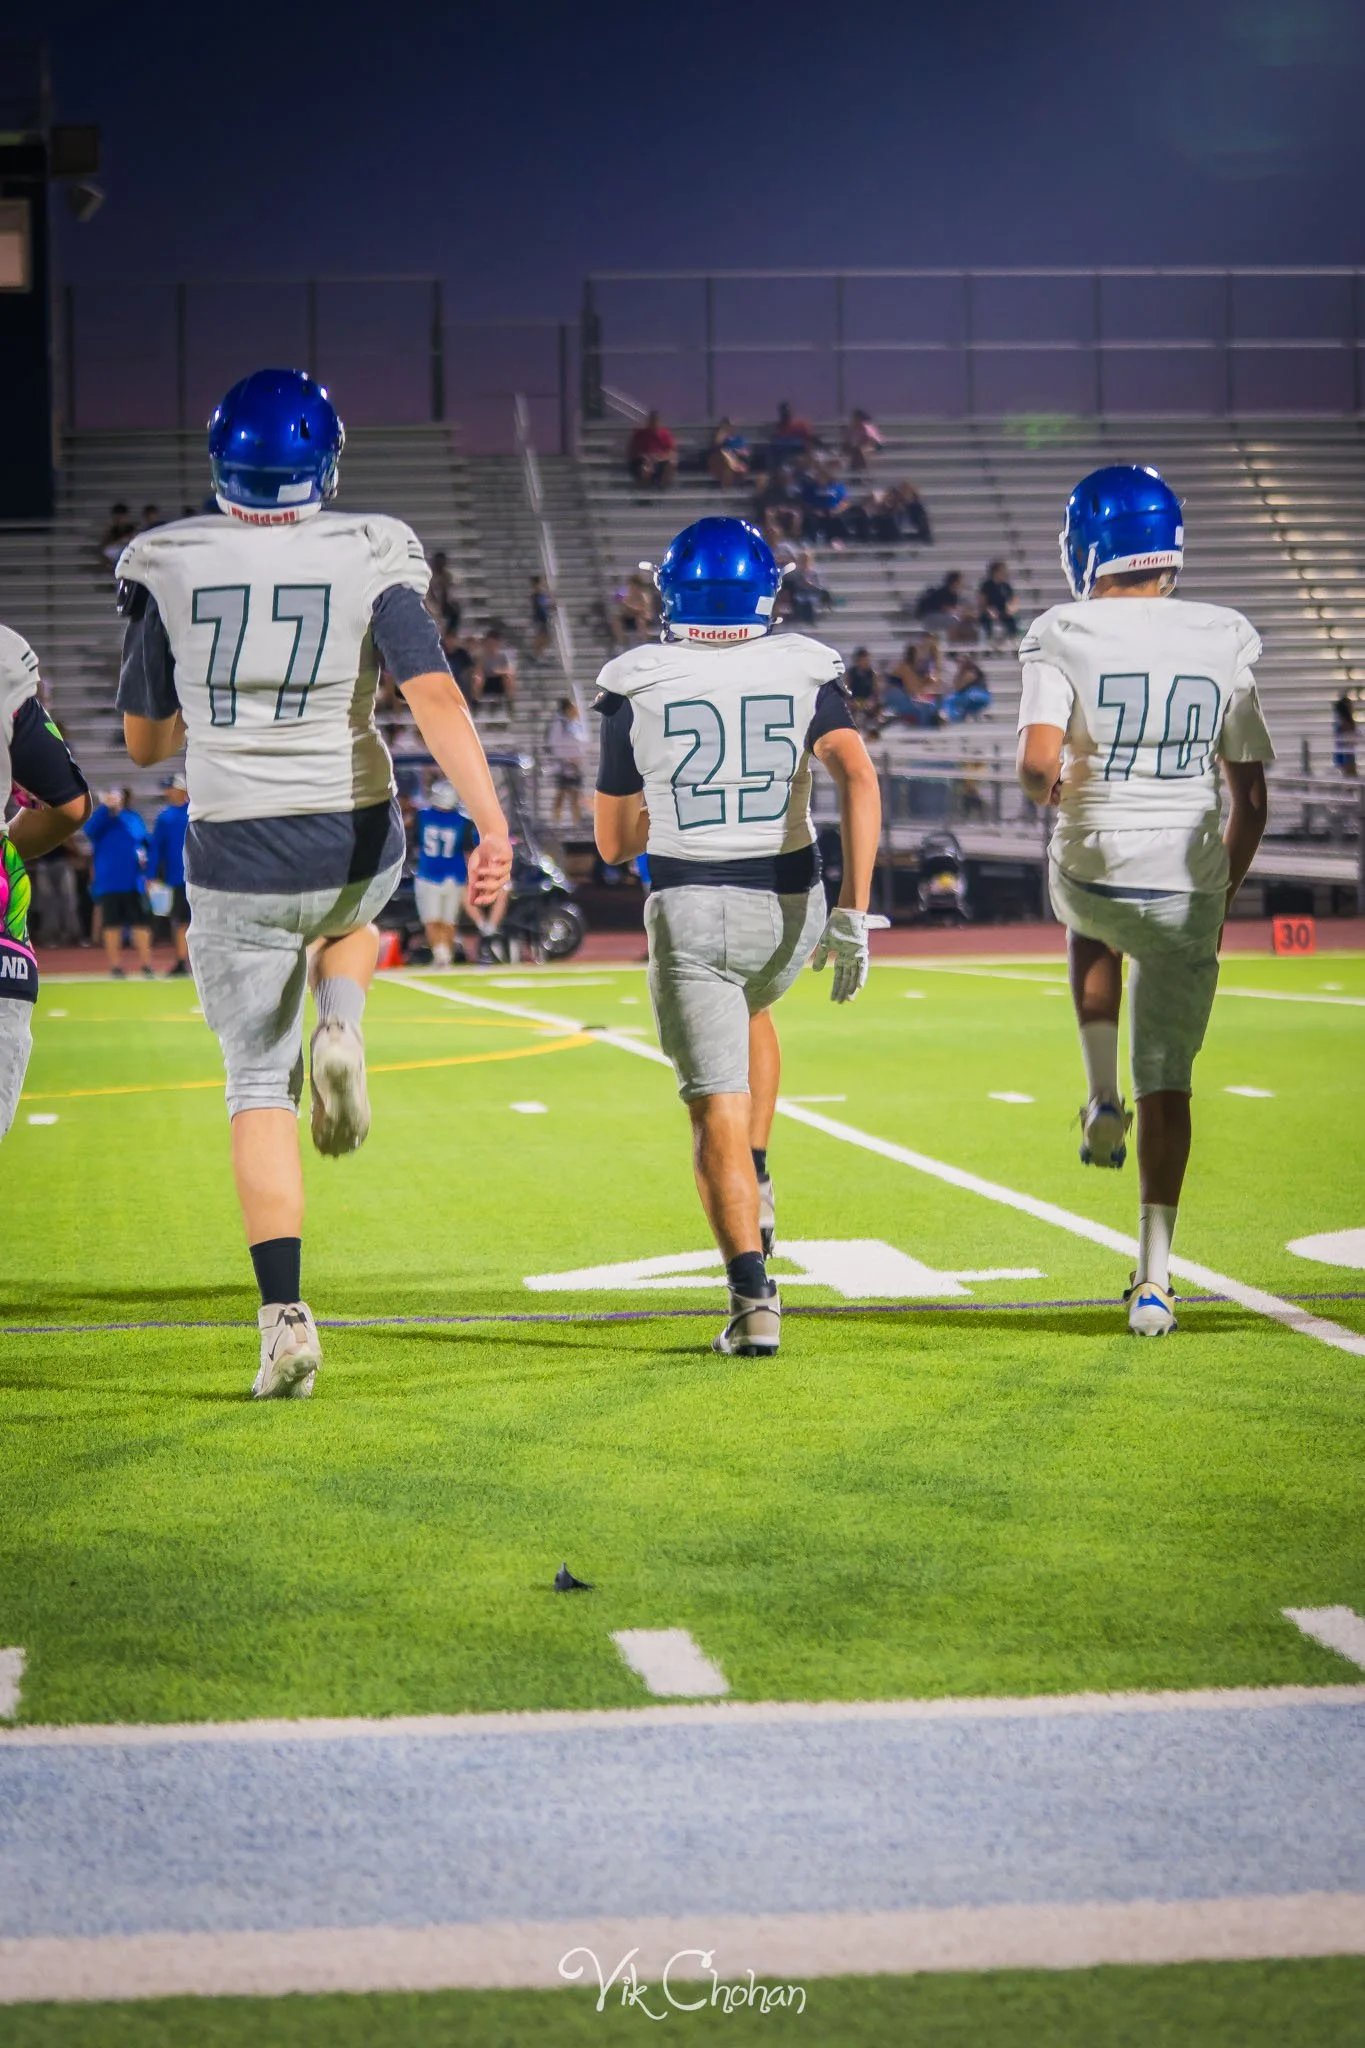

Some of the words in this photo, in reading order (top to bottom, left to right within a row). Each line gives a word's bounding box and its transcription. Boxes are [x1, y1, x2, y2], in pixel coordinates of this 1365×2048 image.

[688, 627, 749, 640] Riddell
[191, 583, 332, 727] 77
[663, 694, 797, 831] 25
[423, 824, 457, 859] 57
[1280, 922, 1311, 950] 30
